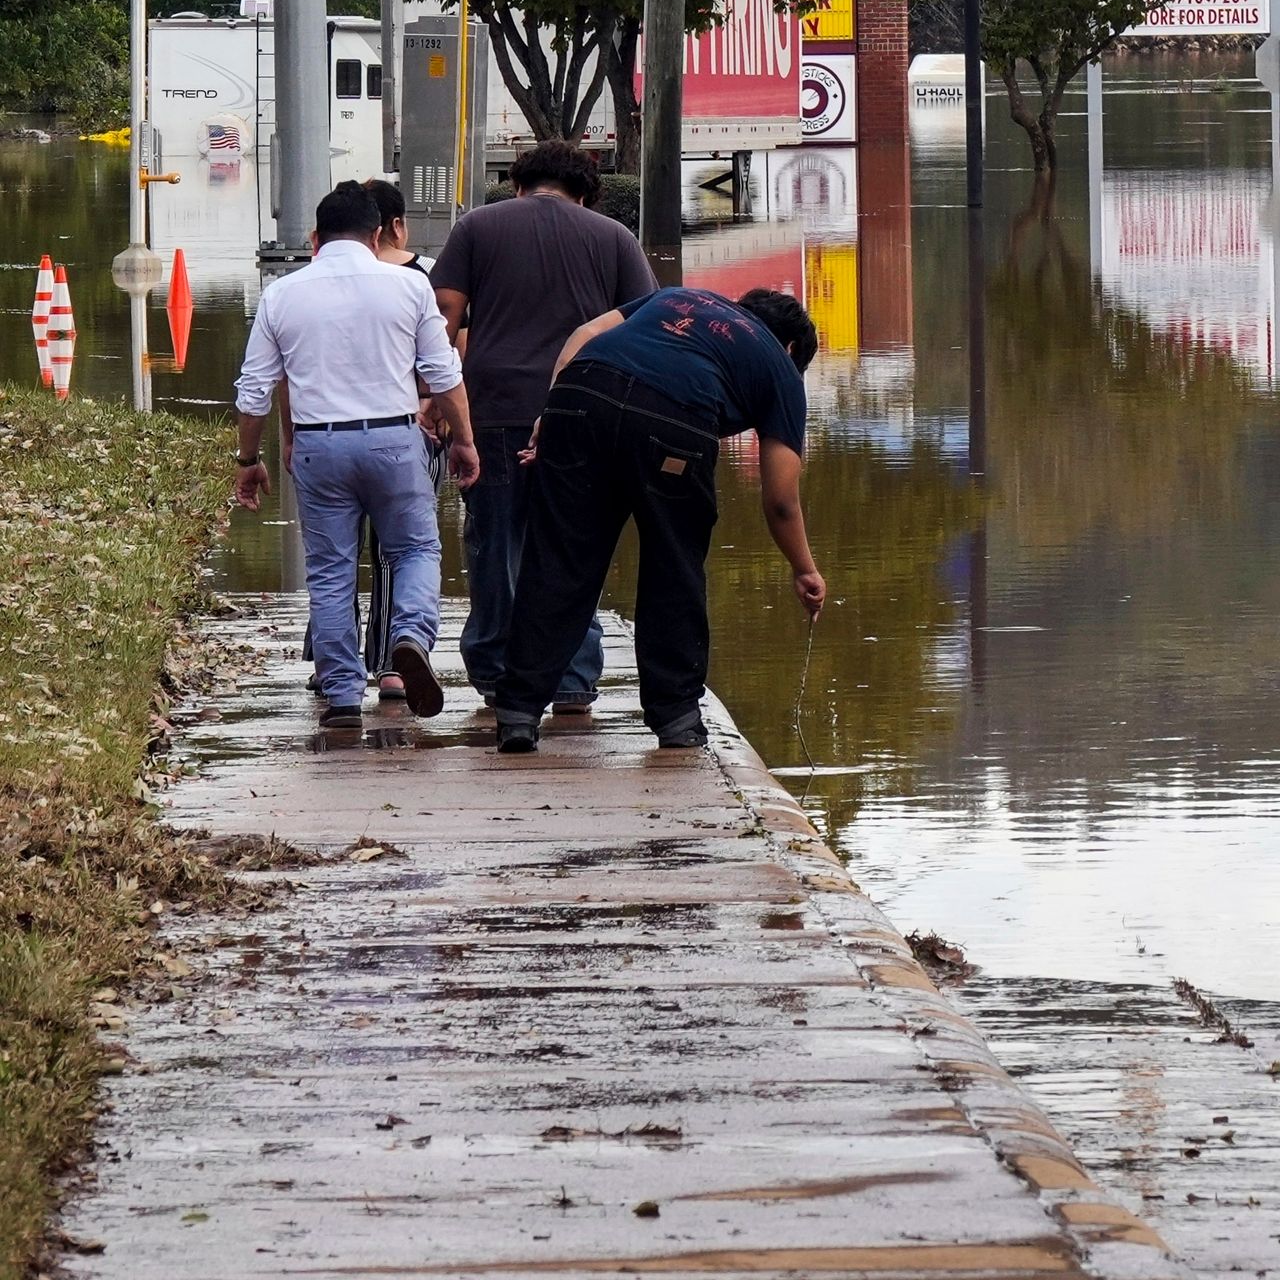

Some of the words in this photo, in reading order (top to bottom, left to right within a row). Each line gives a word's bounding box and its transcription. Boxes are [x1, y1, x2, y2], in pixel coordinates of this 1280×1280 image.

[1144, 9, 1175, 26] TORE
[1179, 9, 1205, 25] FOR
[1208, 8, 1259, 24] DETAILS
[404, 38, 442, 50] 13-1292
[916, 88, 964, 96] U-HAUL
[801, 114, 830, 131] PRESS
